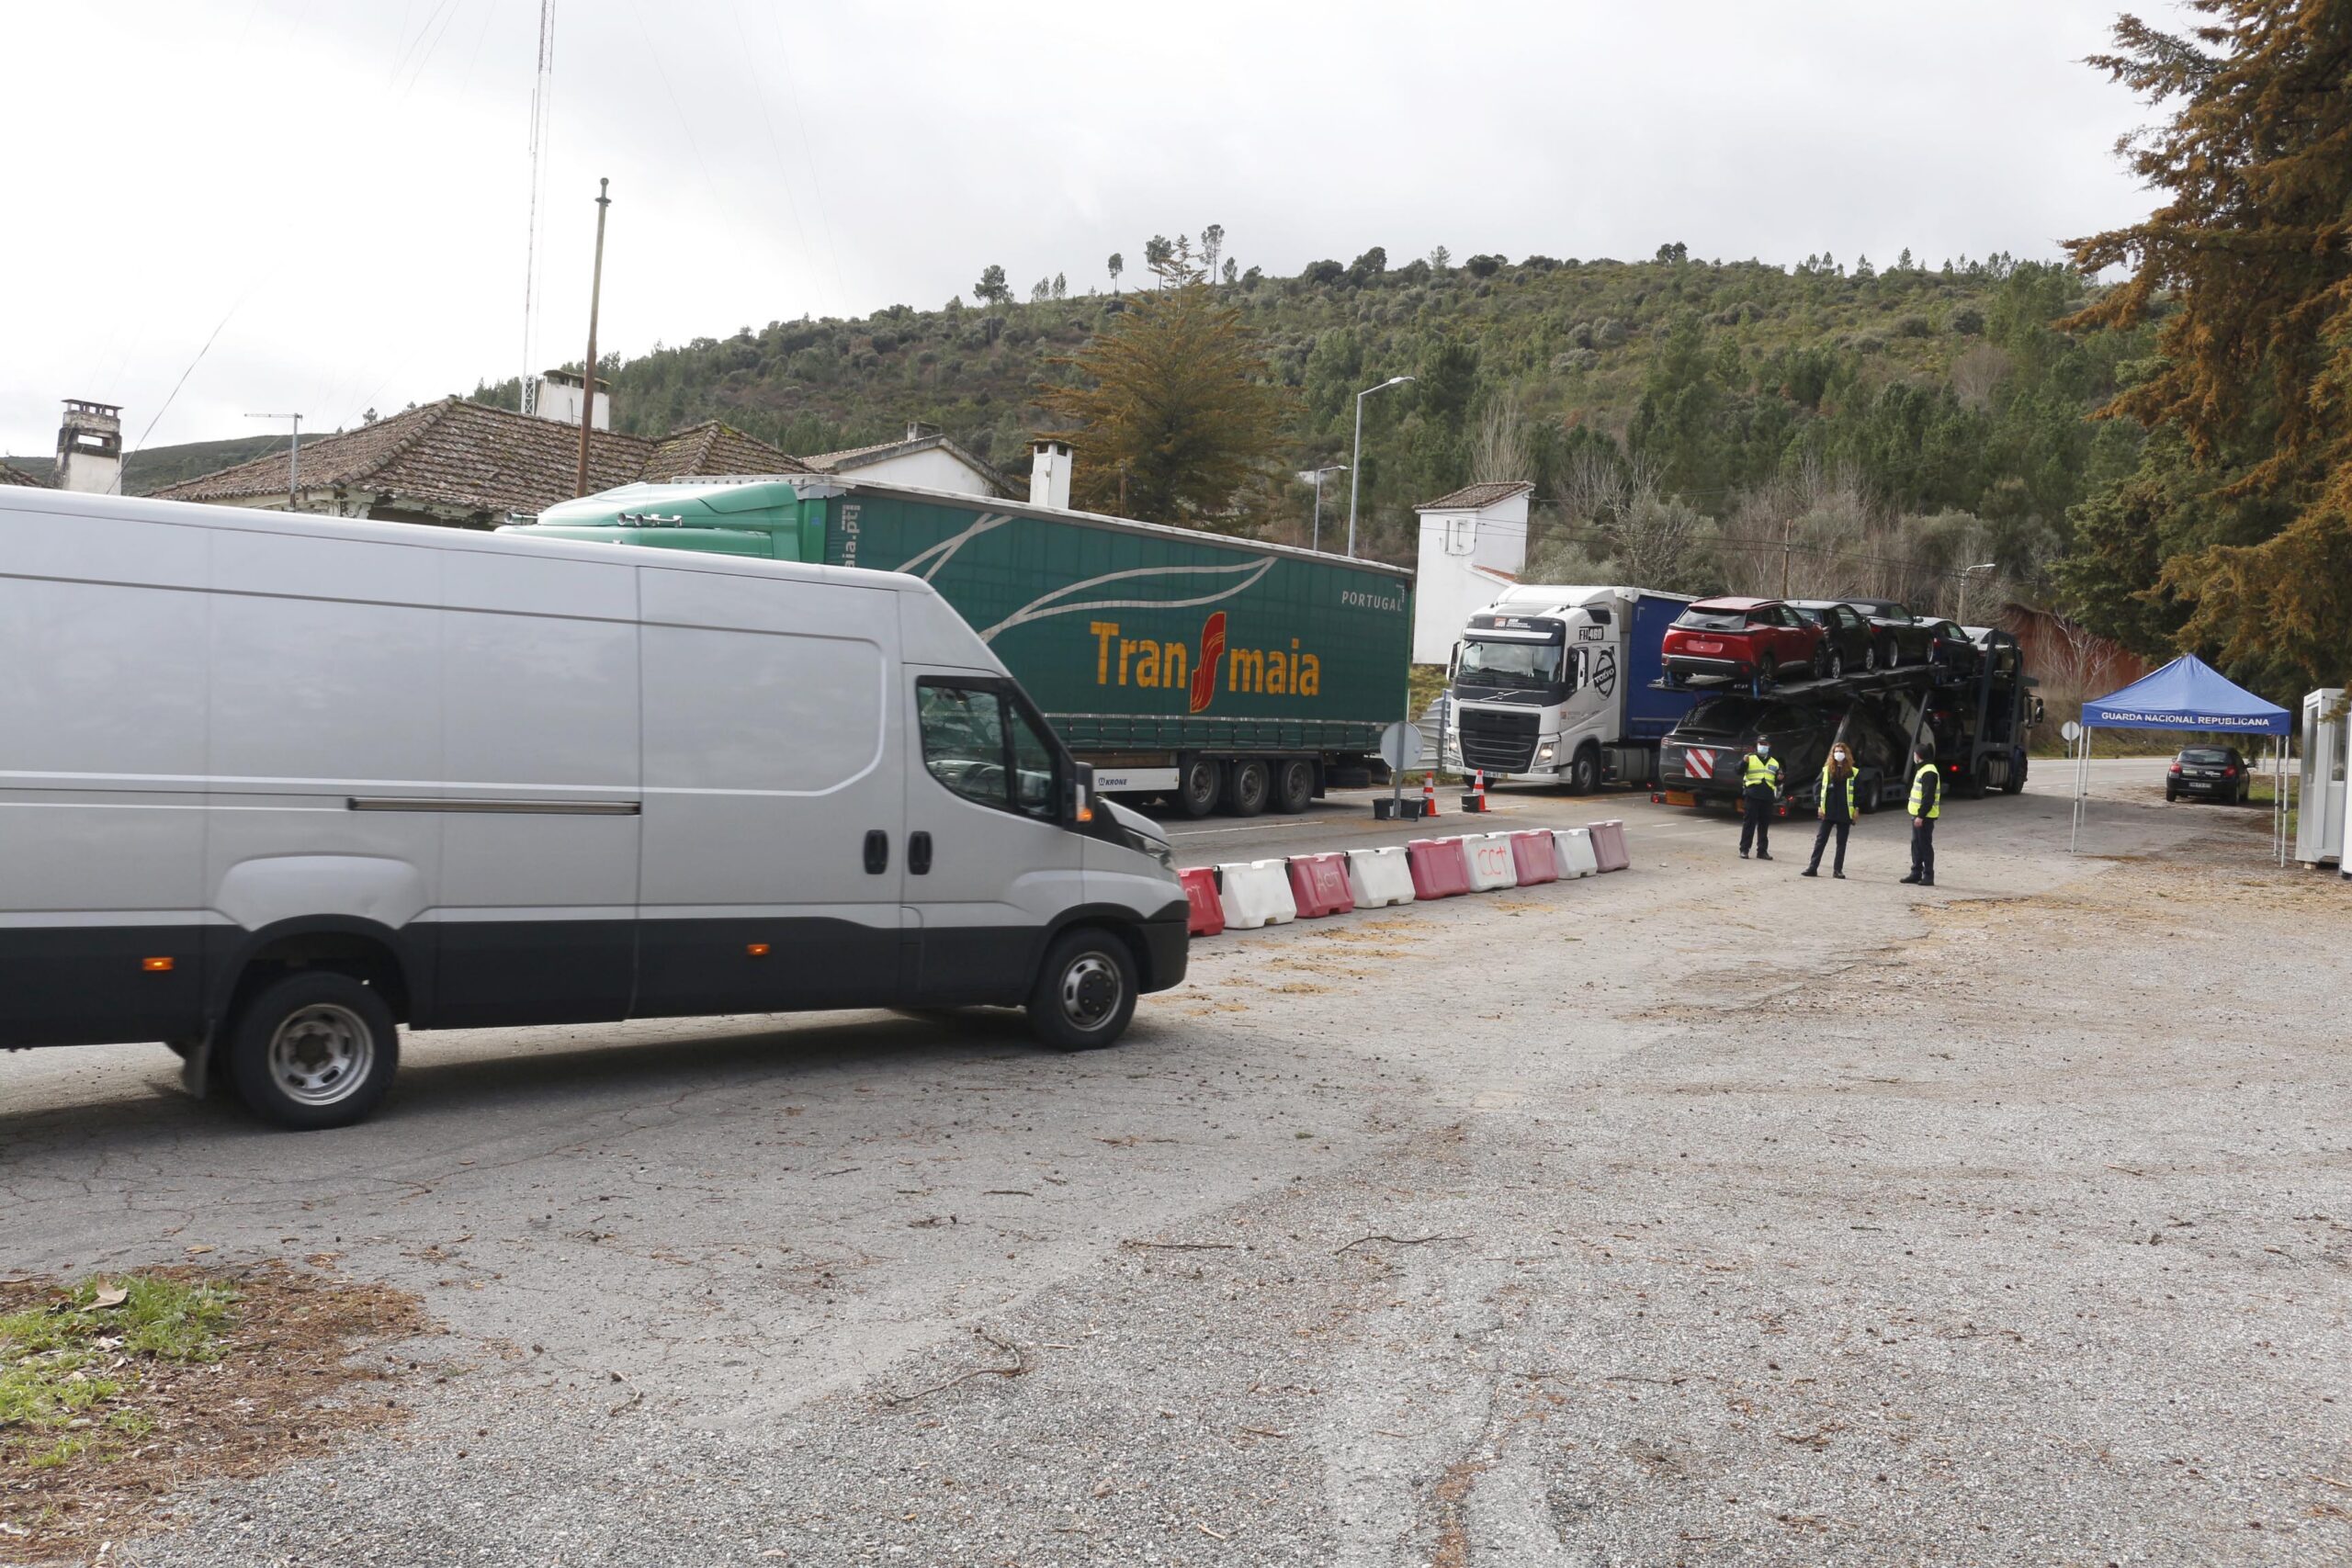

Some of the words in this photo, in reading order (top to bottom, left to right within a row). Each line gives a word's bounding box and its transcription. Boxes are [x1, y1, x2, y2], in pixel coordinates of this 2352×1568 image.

[1341, 591, 1403, 612] PORTUGAL
[2101, 712, 2143, 721] GUARDA
[2144, 714, 2196, 724] NACIONAL
[2198, 716, 2269, 727] REPUBLICANA
